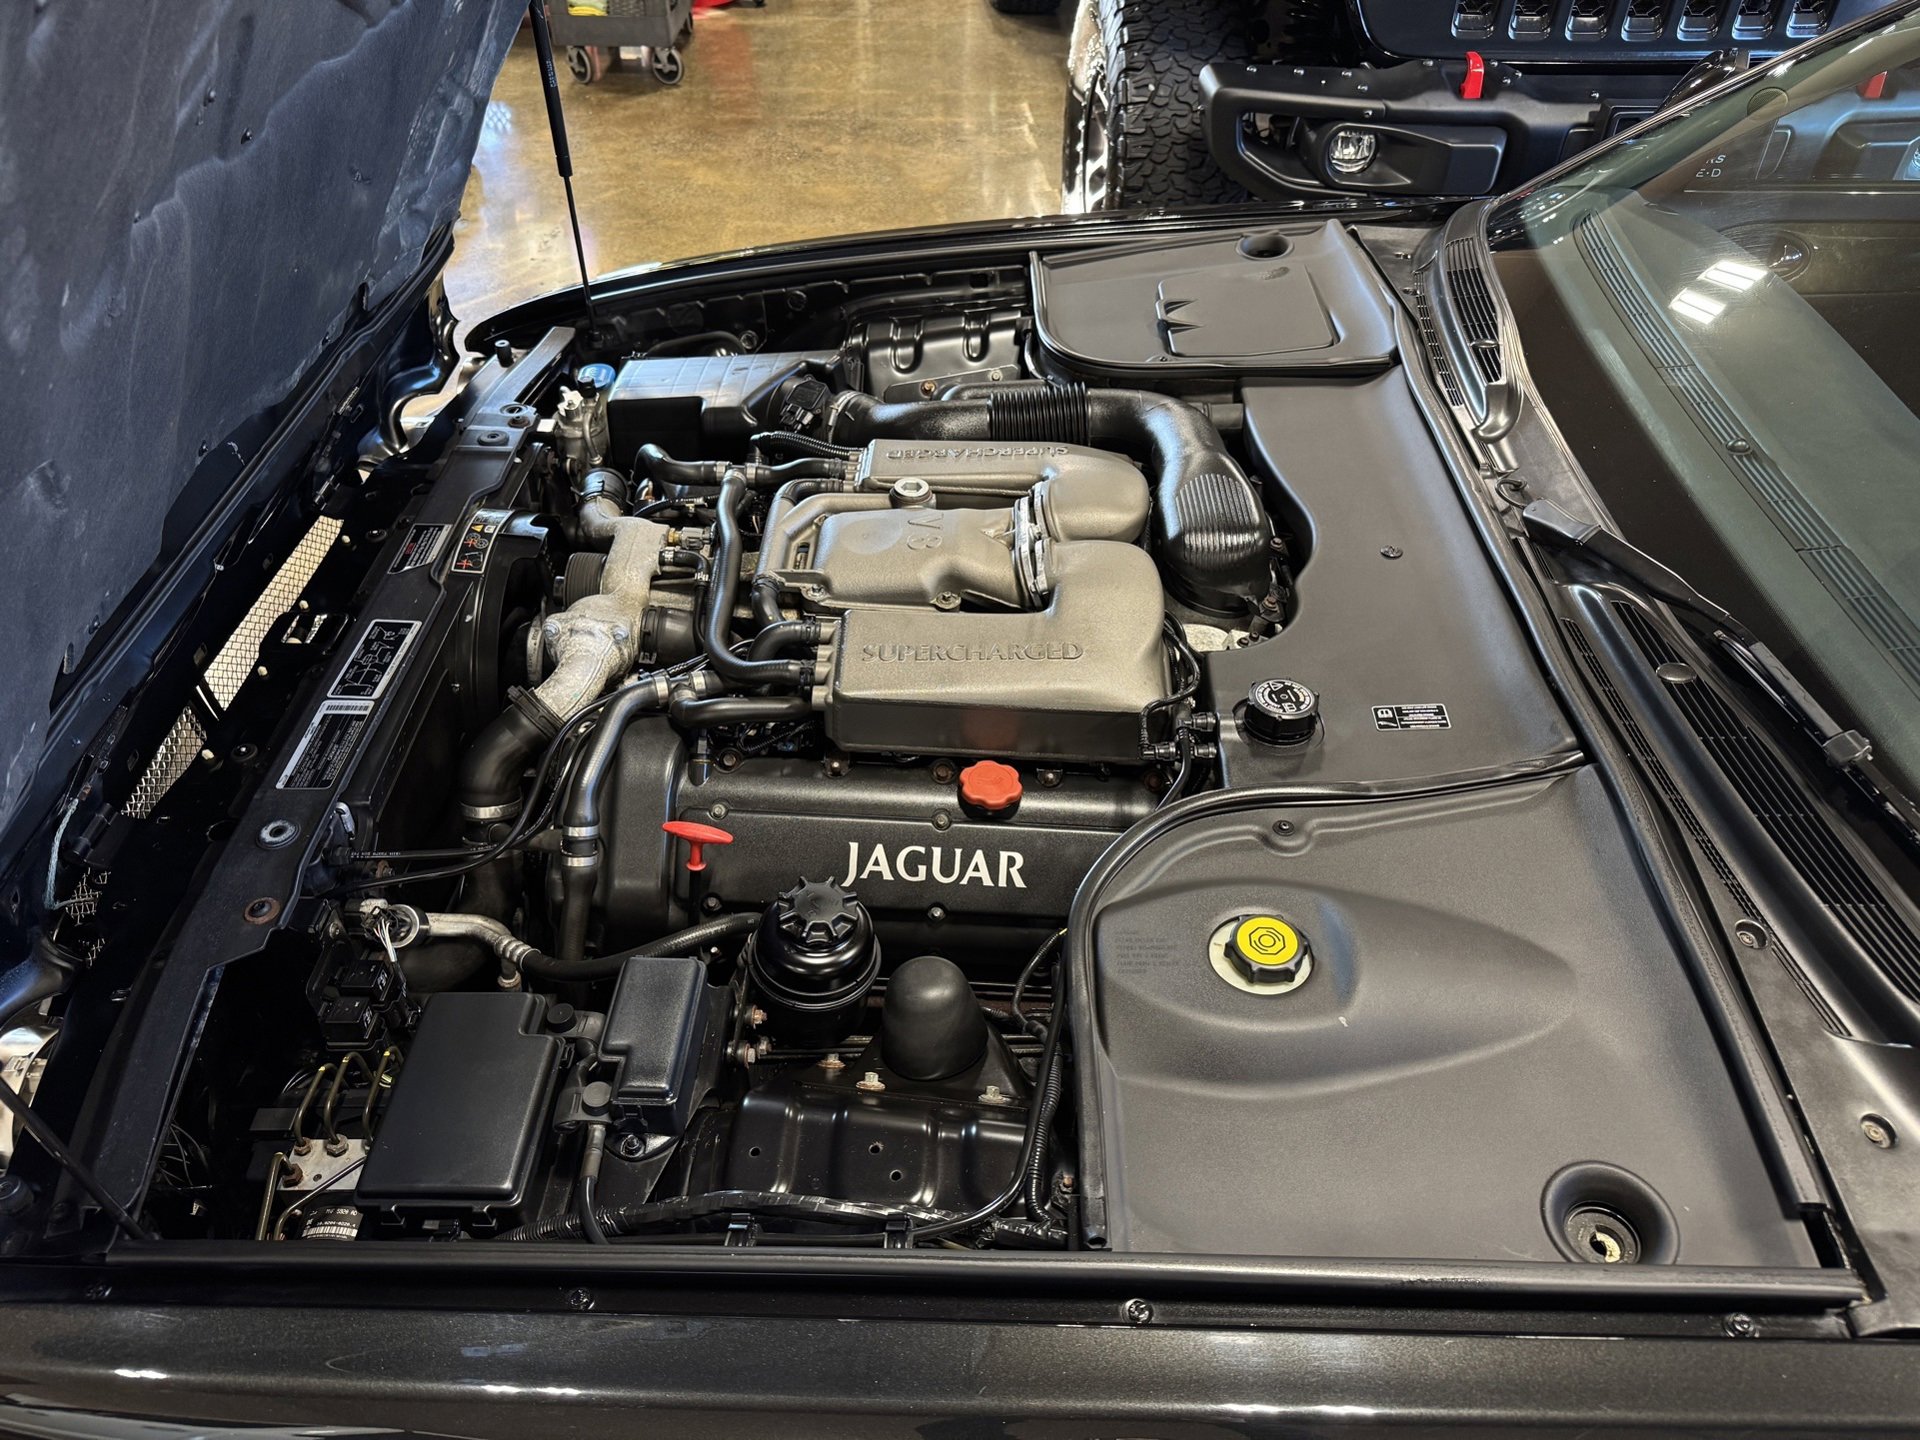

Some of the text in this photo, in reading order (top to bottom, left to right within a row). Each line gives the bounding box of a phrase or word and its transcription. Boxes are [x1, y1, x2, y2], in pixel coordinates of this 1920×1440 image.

[886, 446, 1069, 460] SUPERCHARGED
[861, 641, 1084, 662] SUPERCHARGED
[840, 841, 1027, 889] JAGUAR
